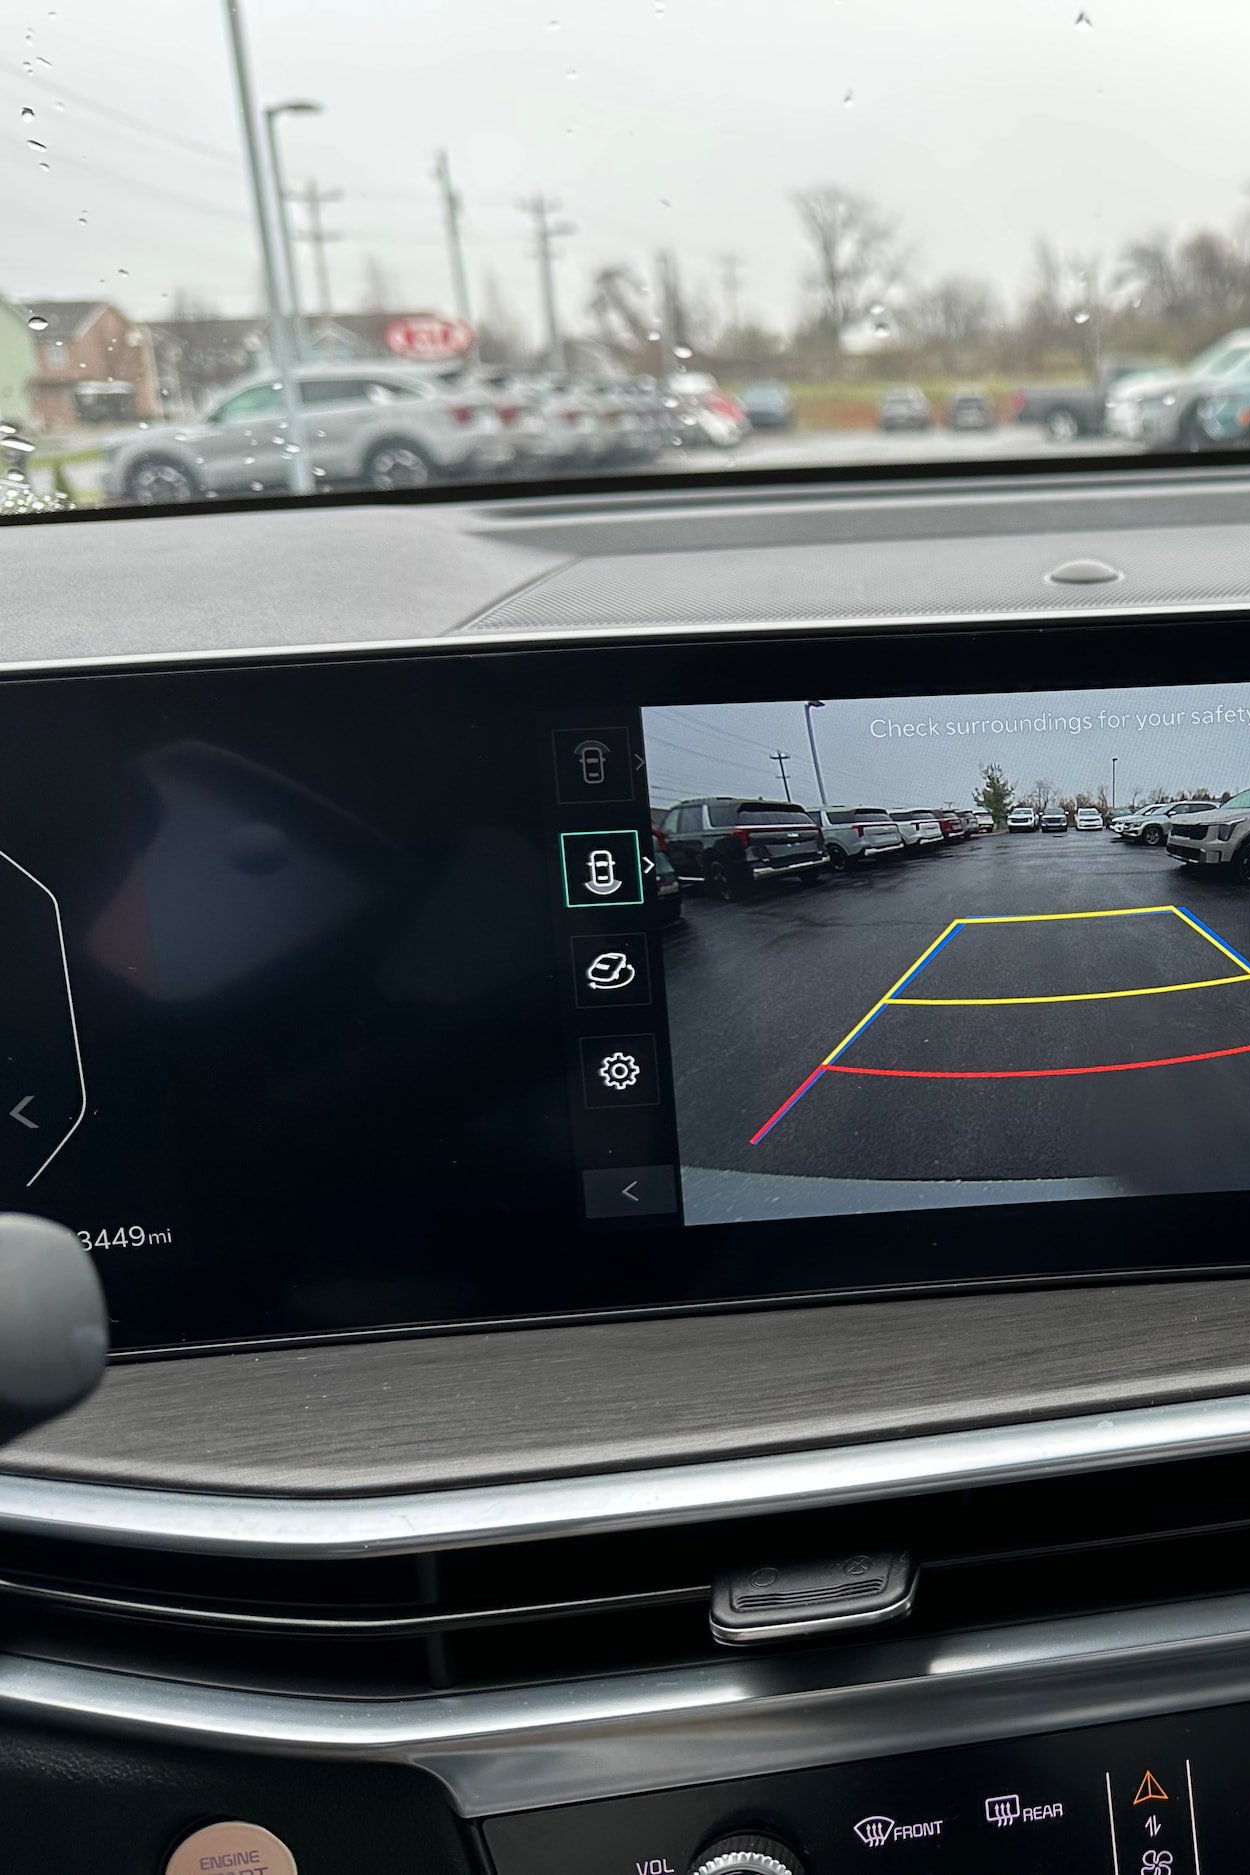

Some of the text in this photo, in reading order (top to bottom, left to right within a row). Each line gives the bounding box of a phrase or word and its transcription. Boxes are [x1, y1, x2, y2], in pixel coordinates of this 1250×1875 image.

[870, 717, 940, 739] Check
[945, 712, 1093, 735] surroundings
[1098, 709, 1130, 730] for
[1135, 711, 1186, 732] your
[1023, 1803, 1064, 1822] REAR
[893, 1820, 944, 1842] FRONT
[200, 1850, 260, 1871] ENGINE
[636, 1858, 675, 1875] VOL
